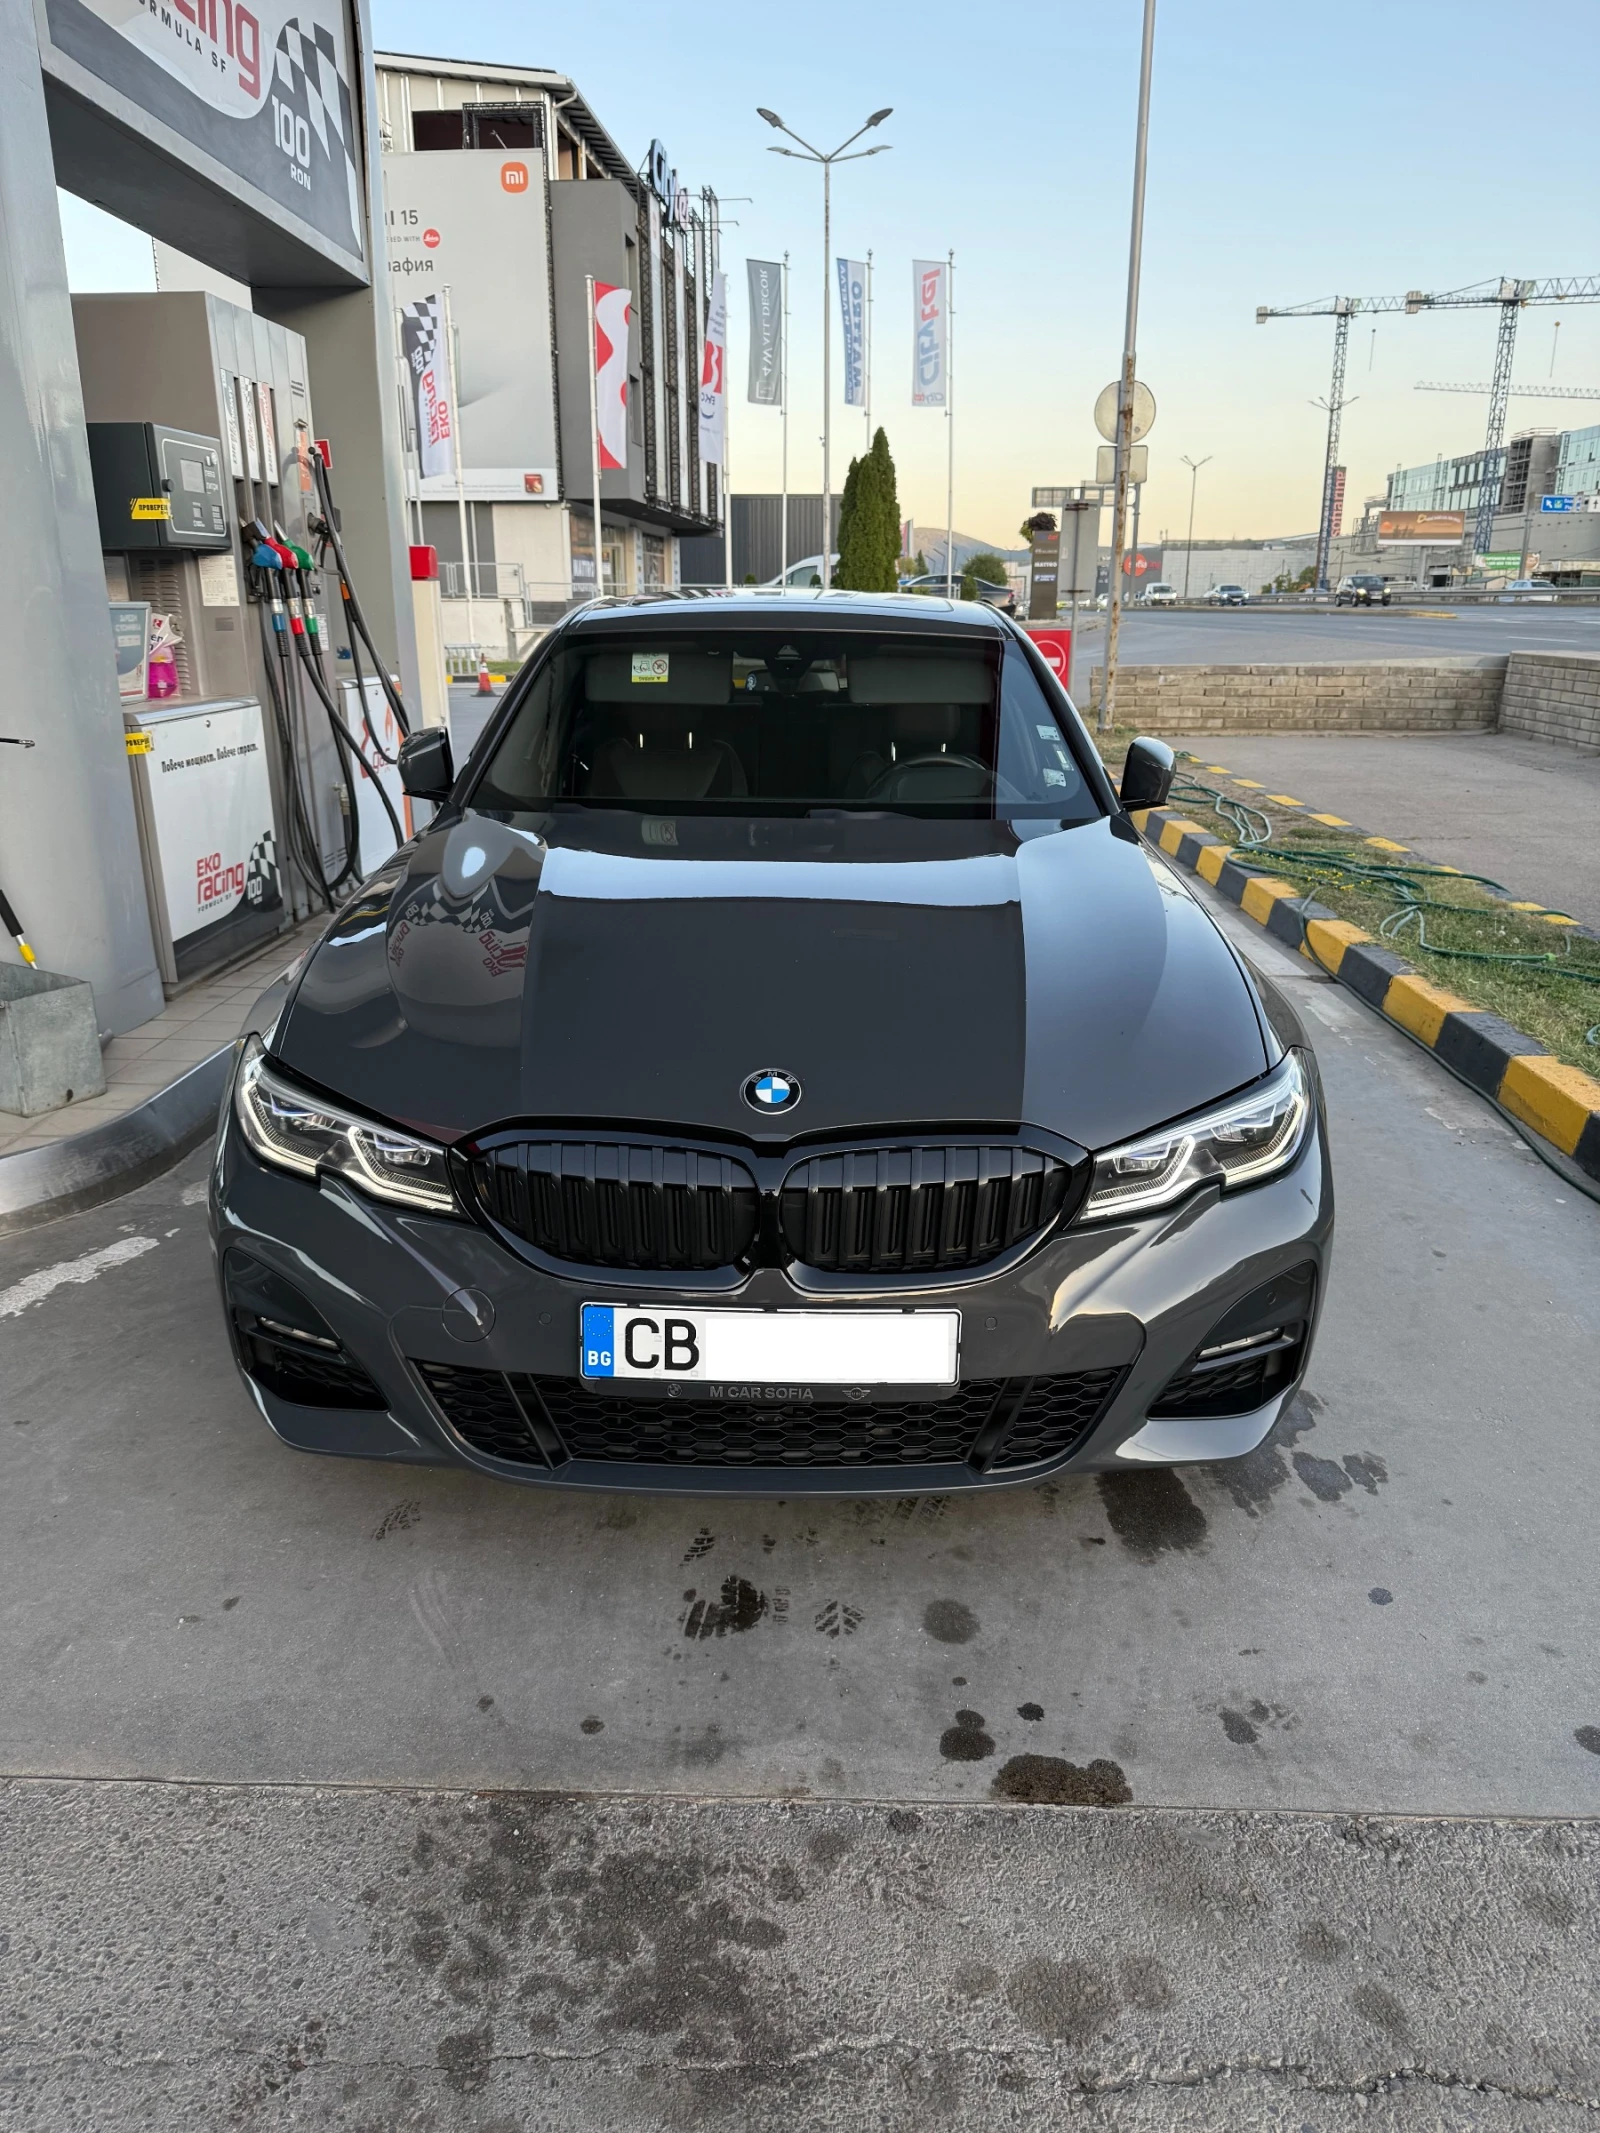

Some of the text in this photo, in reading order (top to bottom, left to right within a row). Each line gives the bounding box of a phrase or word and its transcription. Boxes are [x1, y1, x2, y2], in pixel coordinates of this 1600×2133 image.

[211, 51, 227, 73] SF
[271, 94, 311, 169] 100
[290, 163, 311, 191] RON
[400, 209, 419, 226] 15
[197, 852, 221, 878] EKO
[197, 862, 245, 905] racing
[247, 876, 263, 900] 100
[751, 1071, 797, 1084] BMW
[587, 1317, 700, 1371] BG CB
[709, 1386, 814, 1399] M CAR SOFIA
